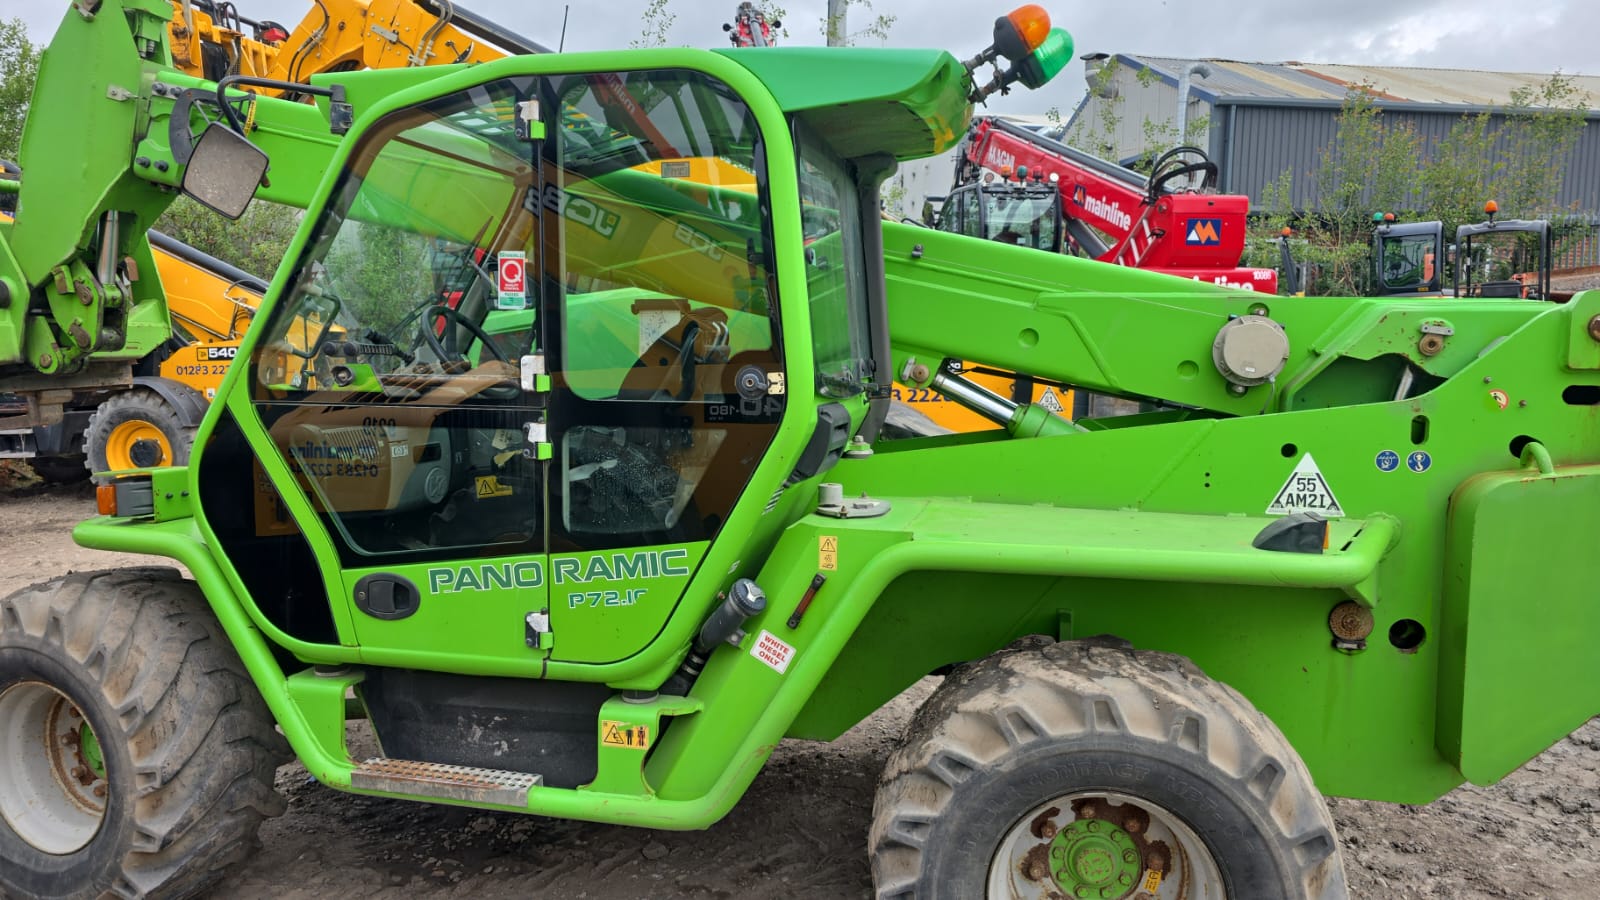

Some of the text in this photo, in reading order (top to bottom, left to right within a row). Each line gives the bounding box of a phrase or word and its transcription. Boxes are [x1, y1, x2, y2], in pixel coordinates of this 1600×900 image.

[1084, 196, 1132, 231] mainline
[502, 260, 522, 283] Q
[208, 347, 238, 358] 540
[212, 365, 231, 375] 22
[1296, 478, 1317, 492] 55
[759, 641, 786, 663] DIESEL
[764, 635, 790, 655] WHITE
[758, 650, 780, 667] ONLY
